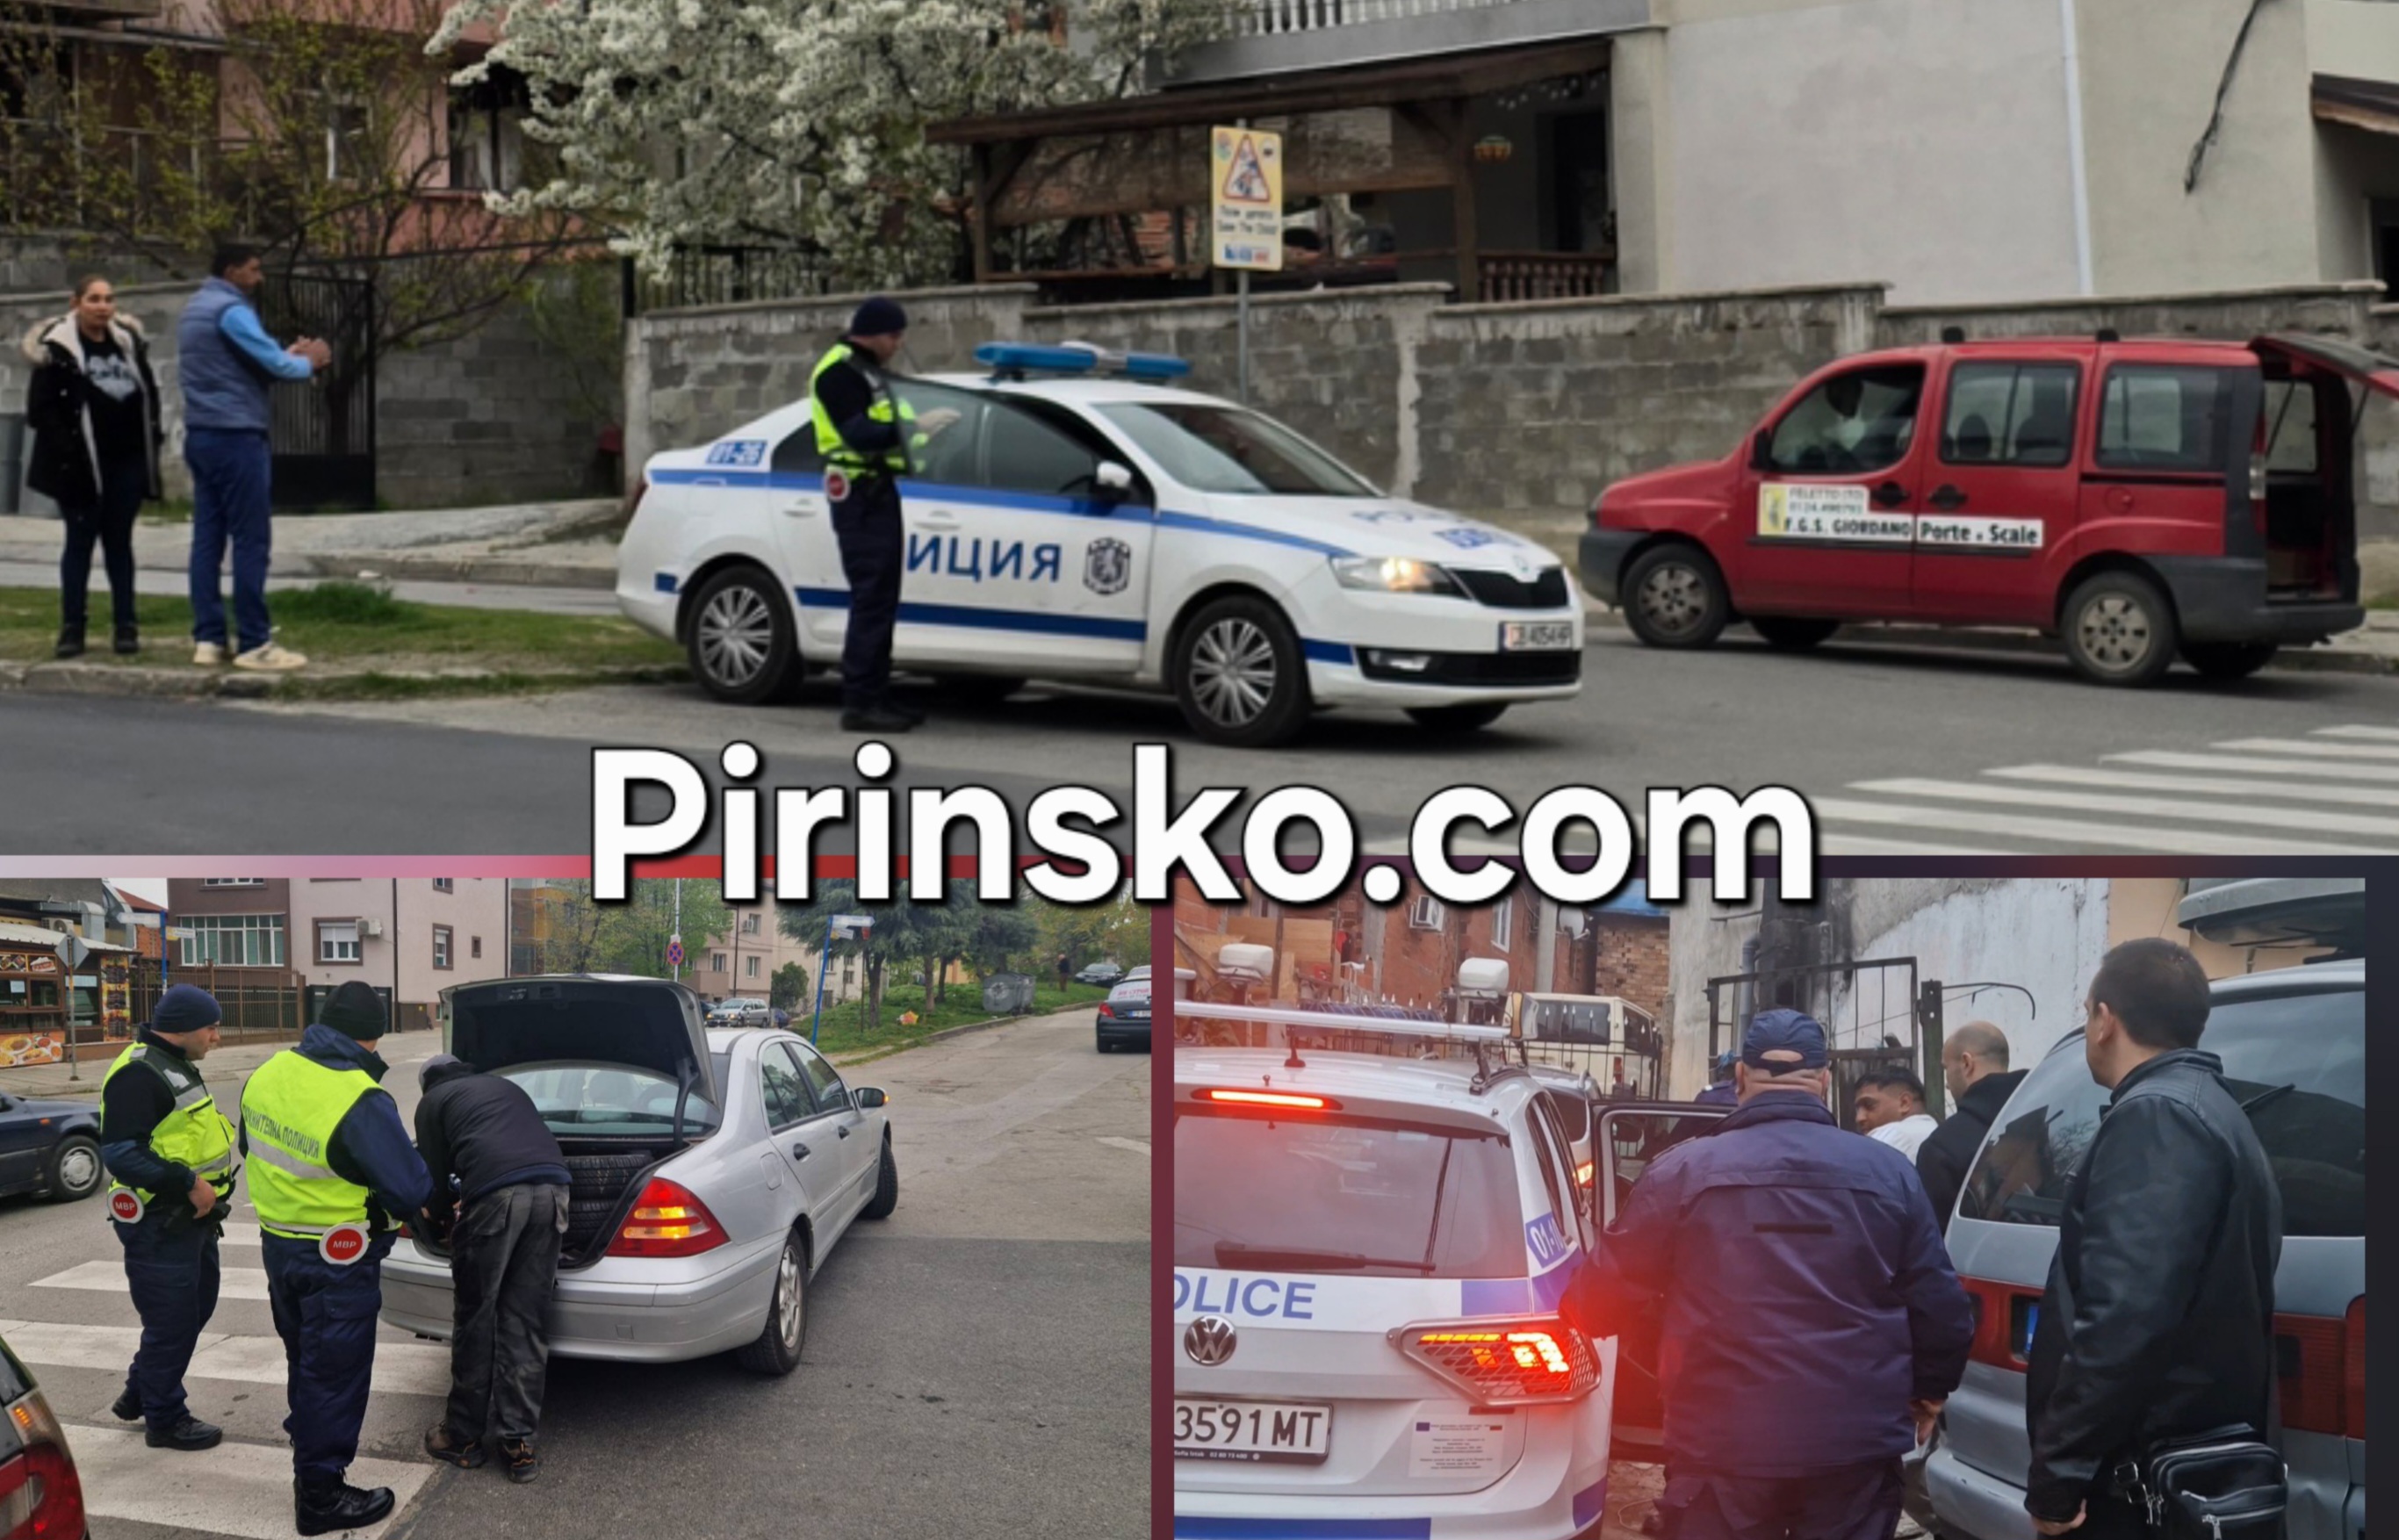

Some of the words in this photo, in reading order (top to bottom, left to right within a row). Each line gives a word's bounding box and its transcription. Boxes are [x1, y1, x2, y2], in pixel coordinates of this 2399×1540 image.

[1832, 518, 1911, 538] GIORDANO
[1920, 522, 1970, 542] Porte
[1989, 523, 2038, 543] Scale
[907, 533, 1062, 583] ИЦИЯ
[283, 1126, 320, 1159] ПОЛИЦИЯ
[115, 1201, 135, 1211] МВР
[1174, 1405, 1262, 1445] 3591
[1272, 1410, 1322, 1447] MT
